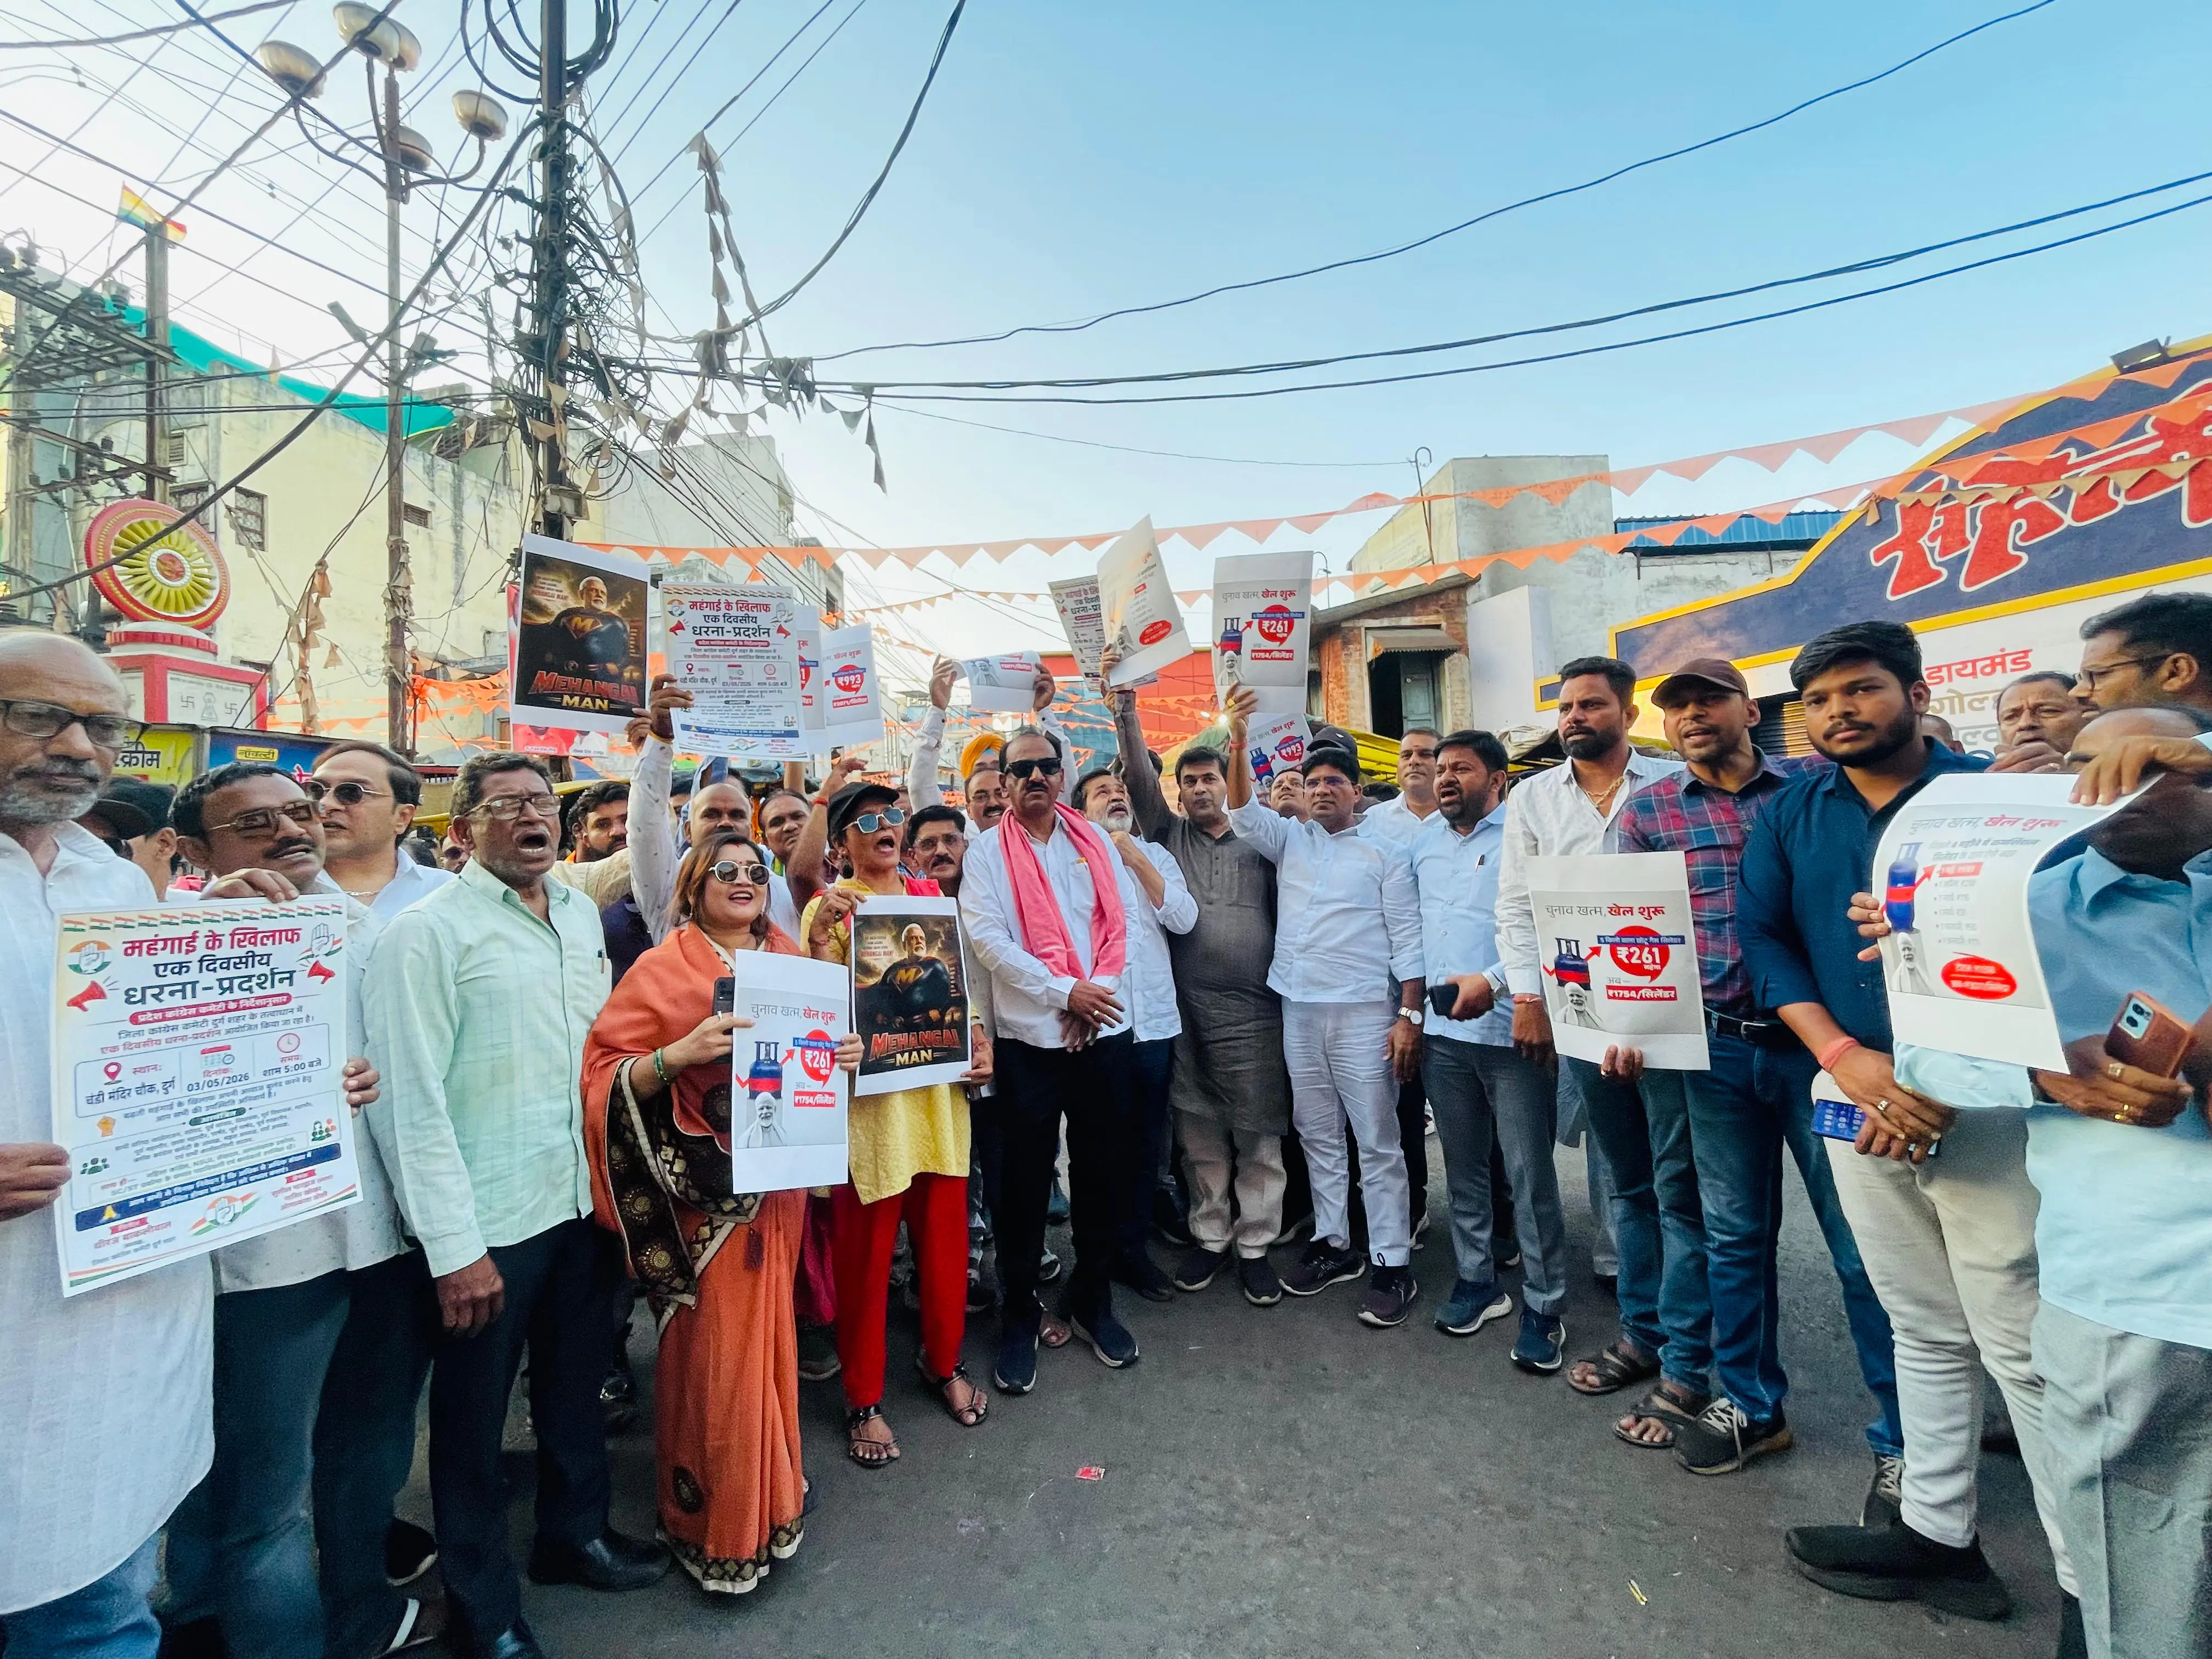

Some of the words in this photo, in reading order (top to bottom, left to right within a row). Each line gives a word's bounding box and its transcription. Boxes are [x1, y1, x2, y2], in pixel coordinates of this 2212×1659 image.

[1222, 592, 1240, 602] चुनाव
[1261, 589, 1278, 598] खेल
[1280, 590, 1296, 601] शुरू
[689, 599, 721, 612] महंगाई
[725, 599, 732, 611] के
[736, 600, 771, 612] खिलाफ
[703, 614, 720, 623] एक
[723, 613, 757, 624] दिवसीय
[1262, 620, 1289, 634] ₹261
[692, 624, 770, 639] धरना-प्रदर्शन
[1925, 647, 2033, 686] डायमंड
[528, 671, 640, 706] MEHANGAI
[838, 674, 861, 686] ₹993
[561, 695, 609, 710] MAN
[239, 749, 275, 760] नॉवल्टी
[1984, 814, 2024, 827] खेल
[2022, 818, 2067, 832] शुरू
[1545, 905, 1573, 918] चुनाव
[1576, 906, 1606, 917] खत्म,
[1607, 904, 1634, 916] खेल
[1638, 906, 1665, 920] शुरू
[122, 930, 199, 957] महंगाई
[204, 929, 223, 951] के
[230, 927, 302, 950] खिलाफ
[1617, 946, 1661, 964] ₹261
[154, 959, 191, 979] एक
[199, 950, 272, 974] दिवसीय
[124, 967, 296, 1006] धरना-प्रदर्शन
[1607, 989, 1675, 1000] ₹1754/सिलेंडर
[137, 1011, 163, 1023] प्रदेश
[199, 1002, 225, 1014] कमेटी
[227, 1000, 238, 1010] के
[751, 1003, 778, 1018] चुनाव
[780, 1006, 801, 1019] खत्म,
[803, 1006, 820, 1019] खेल
[821, 1011, 837, 1025] शुरू
[118, 1028, 144, 1040] जिला
[182, 1018, 209, 1030] कमेटी
[212, 1016, 225, 1030] दुर्ग
[227, 1015, 246, 1024] शहर
[250, 1012, 258, 1021] के
[100, 1046, 120, 1055] एक
[868, 1029, 961, 1062] MEHANGAI
[805, 1050, 831, 1068] ₹261
[895, 1048, 933, 1066] MAN
[263, 1066, 281, 1077] शाम
[284, 1062, 306, 1074] 5:00
[309, 1058, 322, 1069] बजे
[85, 1089, 105, 1105] चंडी
[108, 1085, 132, 1102] मंदिर
[134, 1080, 160, 1096] चौक,
[162, 1076, 175, 1096] दुर्ग
[187, 1073, 250, 1092] 03/05/2026
[795, 1093, 835, 1105] ₹1754/सिलेंडर
